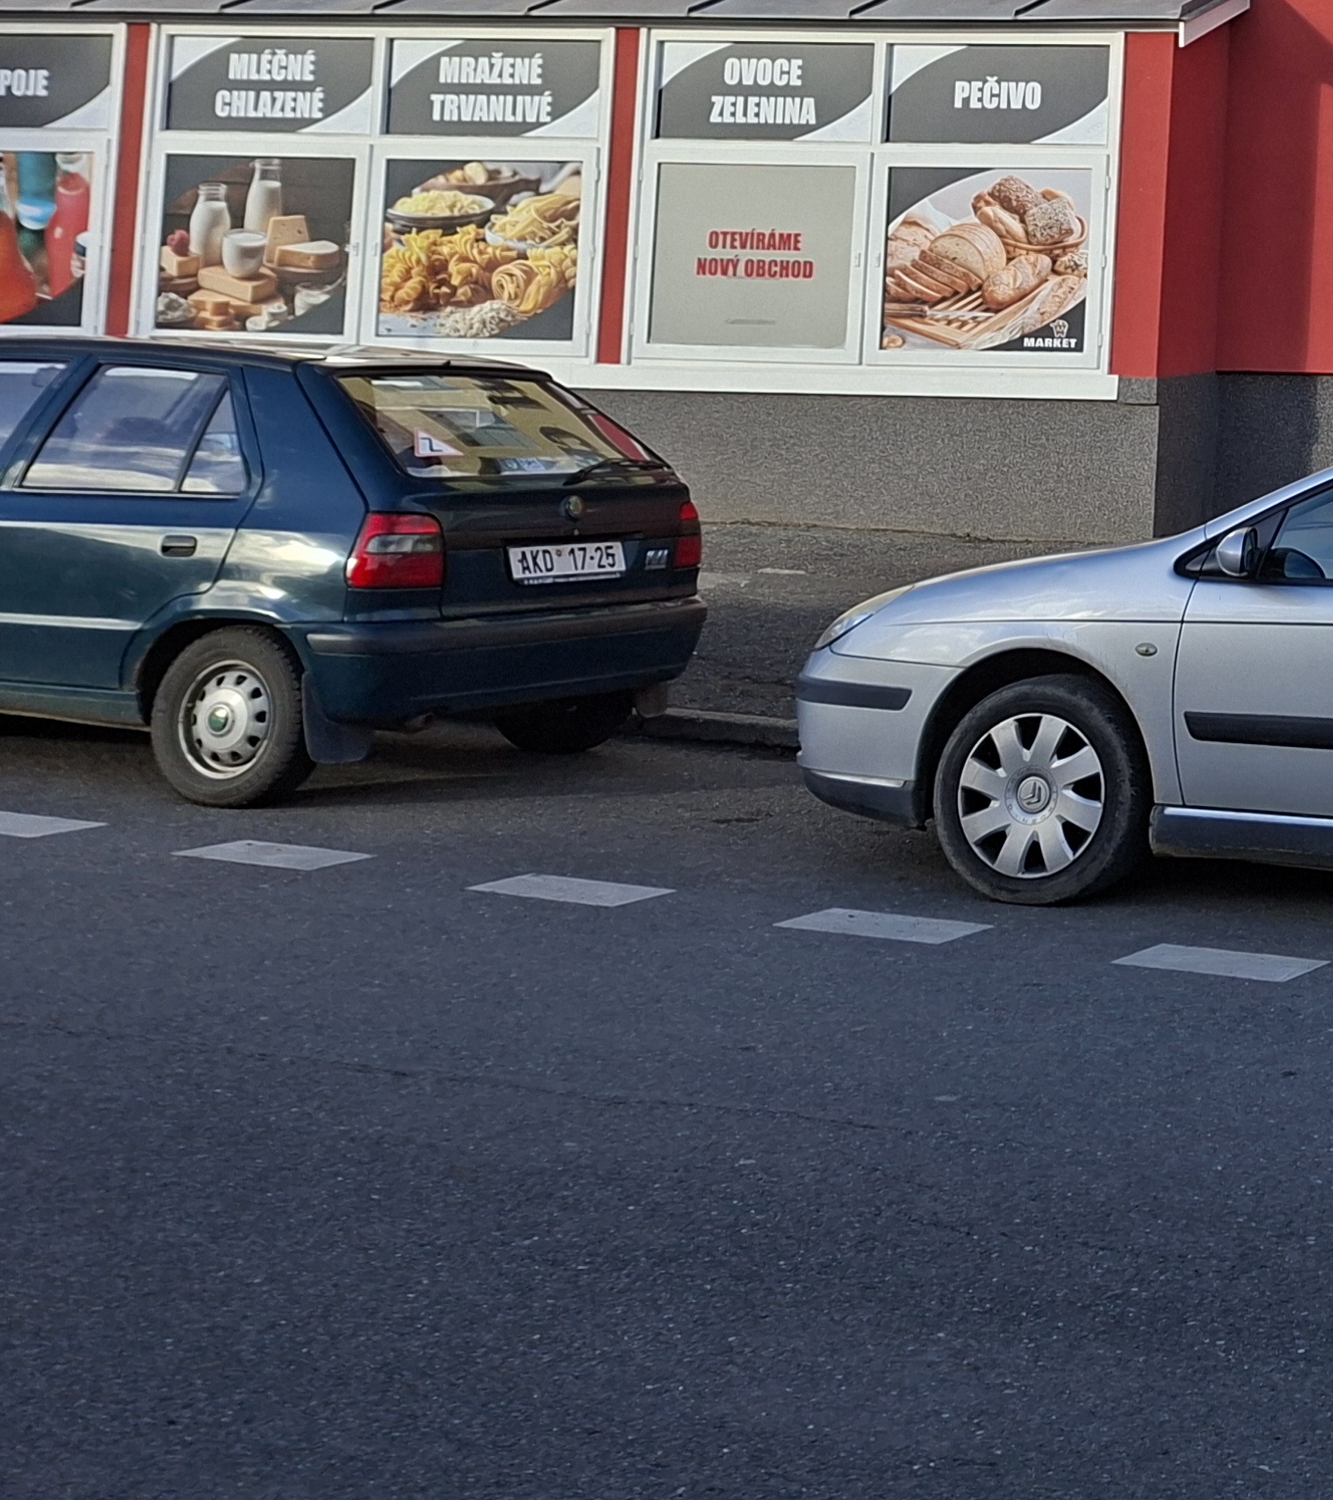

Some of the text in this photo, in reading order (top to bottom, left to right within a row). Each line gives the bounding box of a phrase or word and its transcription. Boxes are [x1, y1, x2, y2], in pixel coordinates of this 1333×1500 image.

[228, 49, 316, 81] MLÉČNÉ
[439, 52, 543, 85] MRAŽENÉ
[723, 58, 802, 86] OVOCE
[214, 87, 324, 118] CHLAZENÉ
[430, 91, 552, 122] TRVANLIVÉ
[954, 76, 1042, 110] PEČIVO
[709, 95, 816, 124] ZELENINA
[708, 228, 802, 251] OTEVÍRÁME
[696, 254, 814, 279] NOVÝ OBCHOD
[1023, 337, 1077, 348] MARKET
[518, 549, 554, 575] AKD
